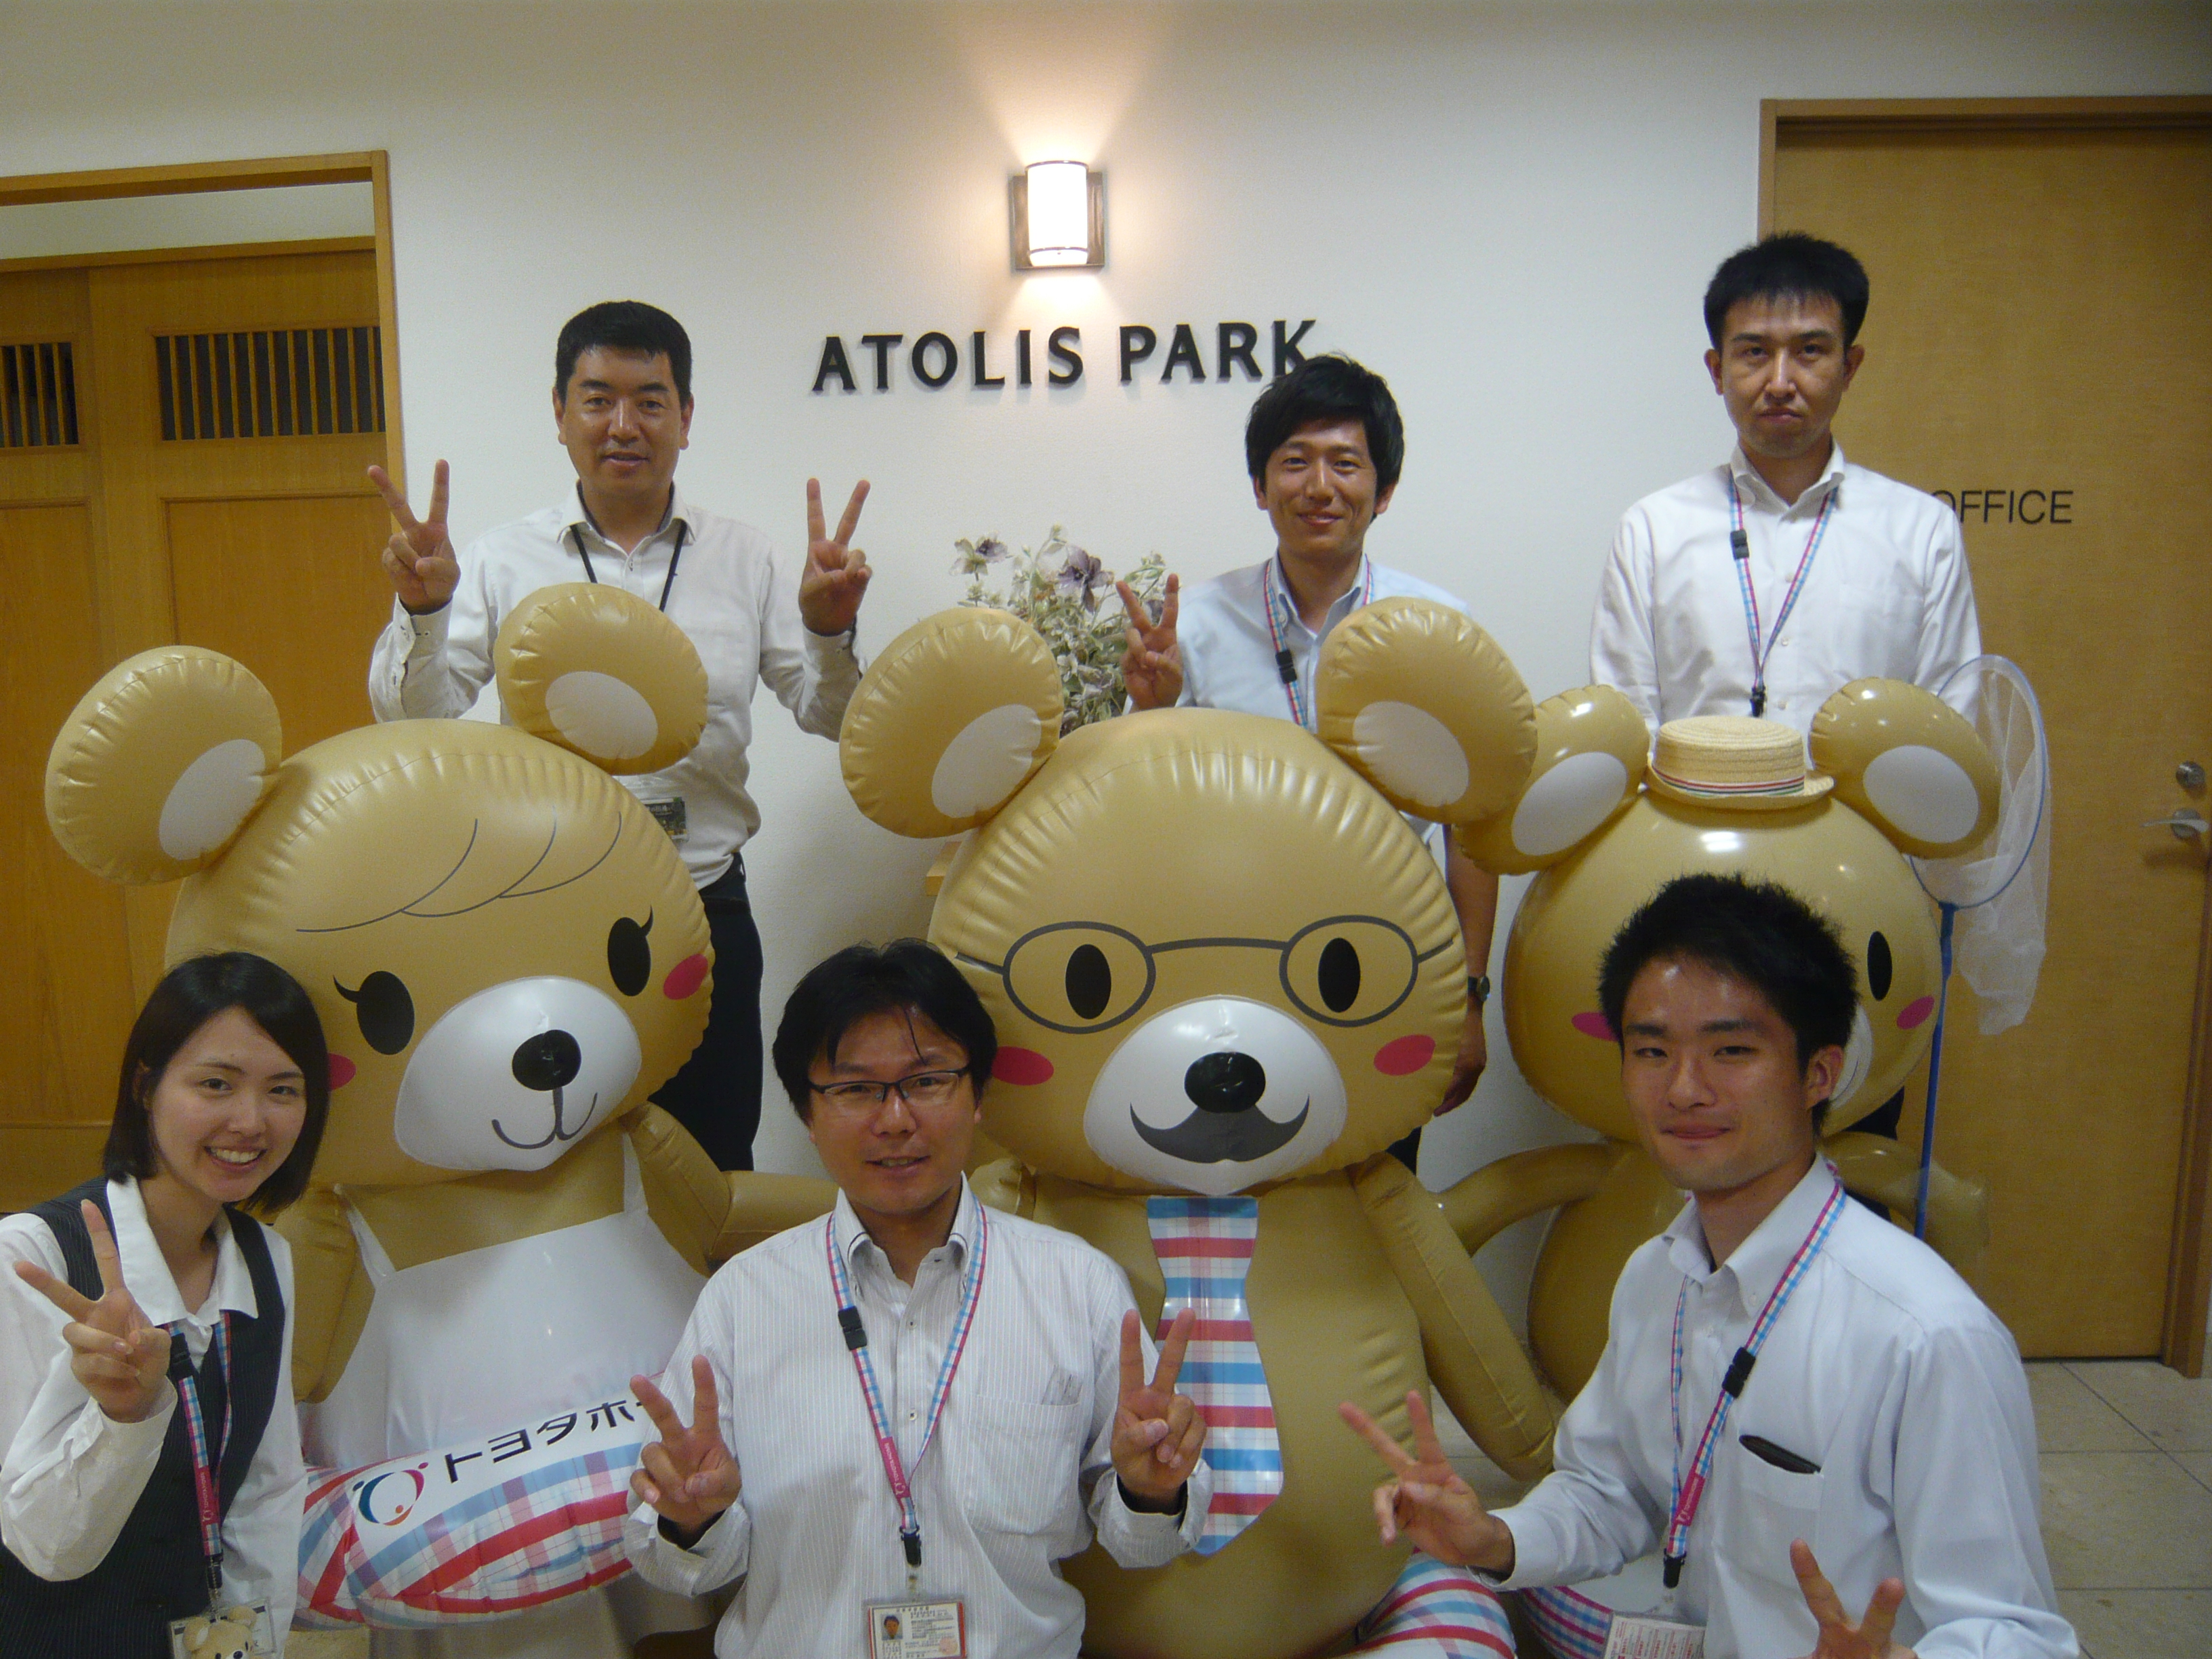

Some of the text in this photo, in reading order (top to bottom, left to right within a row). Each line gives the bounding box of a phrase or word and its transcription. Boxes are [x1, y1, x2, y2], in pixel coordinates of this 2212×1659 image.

[813, 319, 1317, 392] ATOLIS PARK
[445, 1399, 644, 1484] トヨタホ
